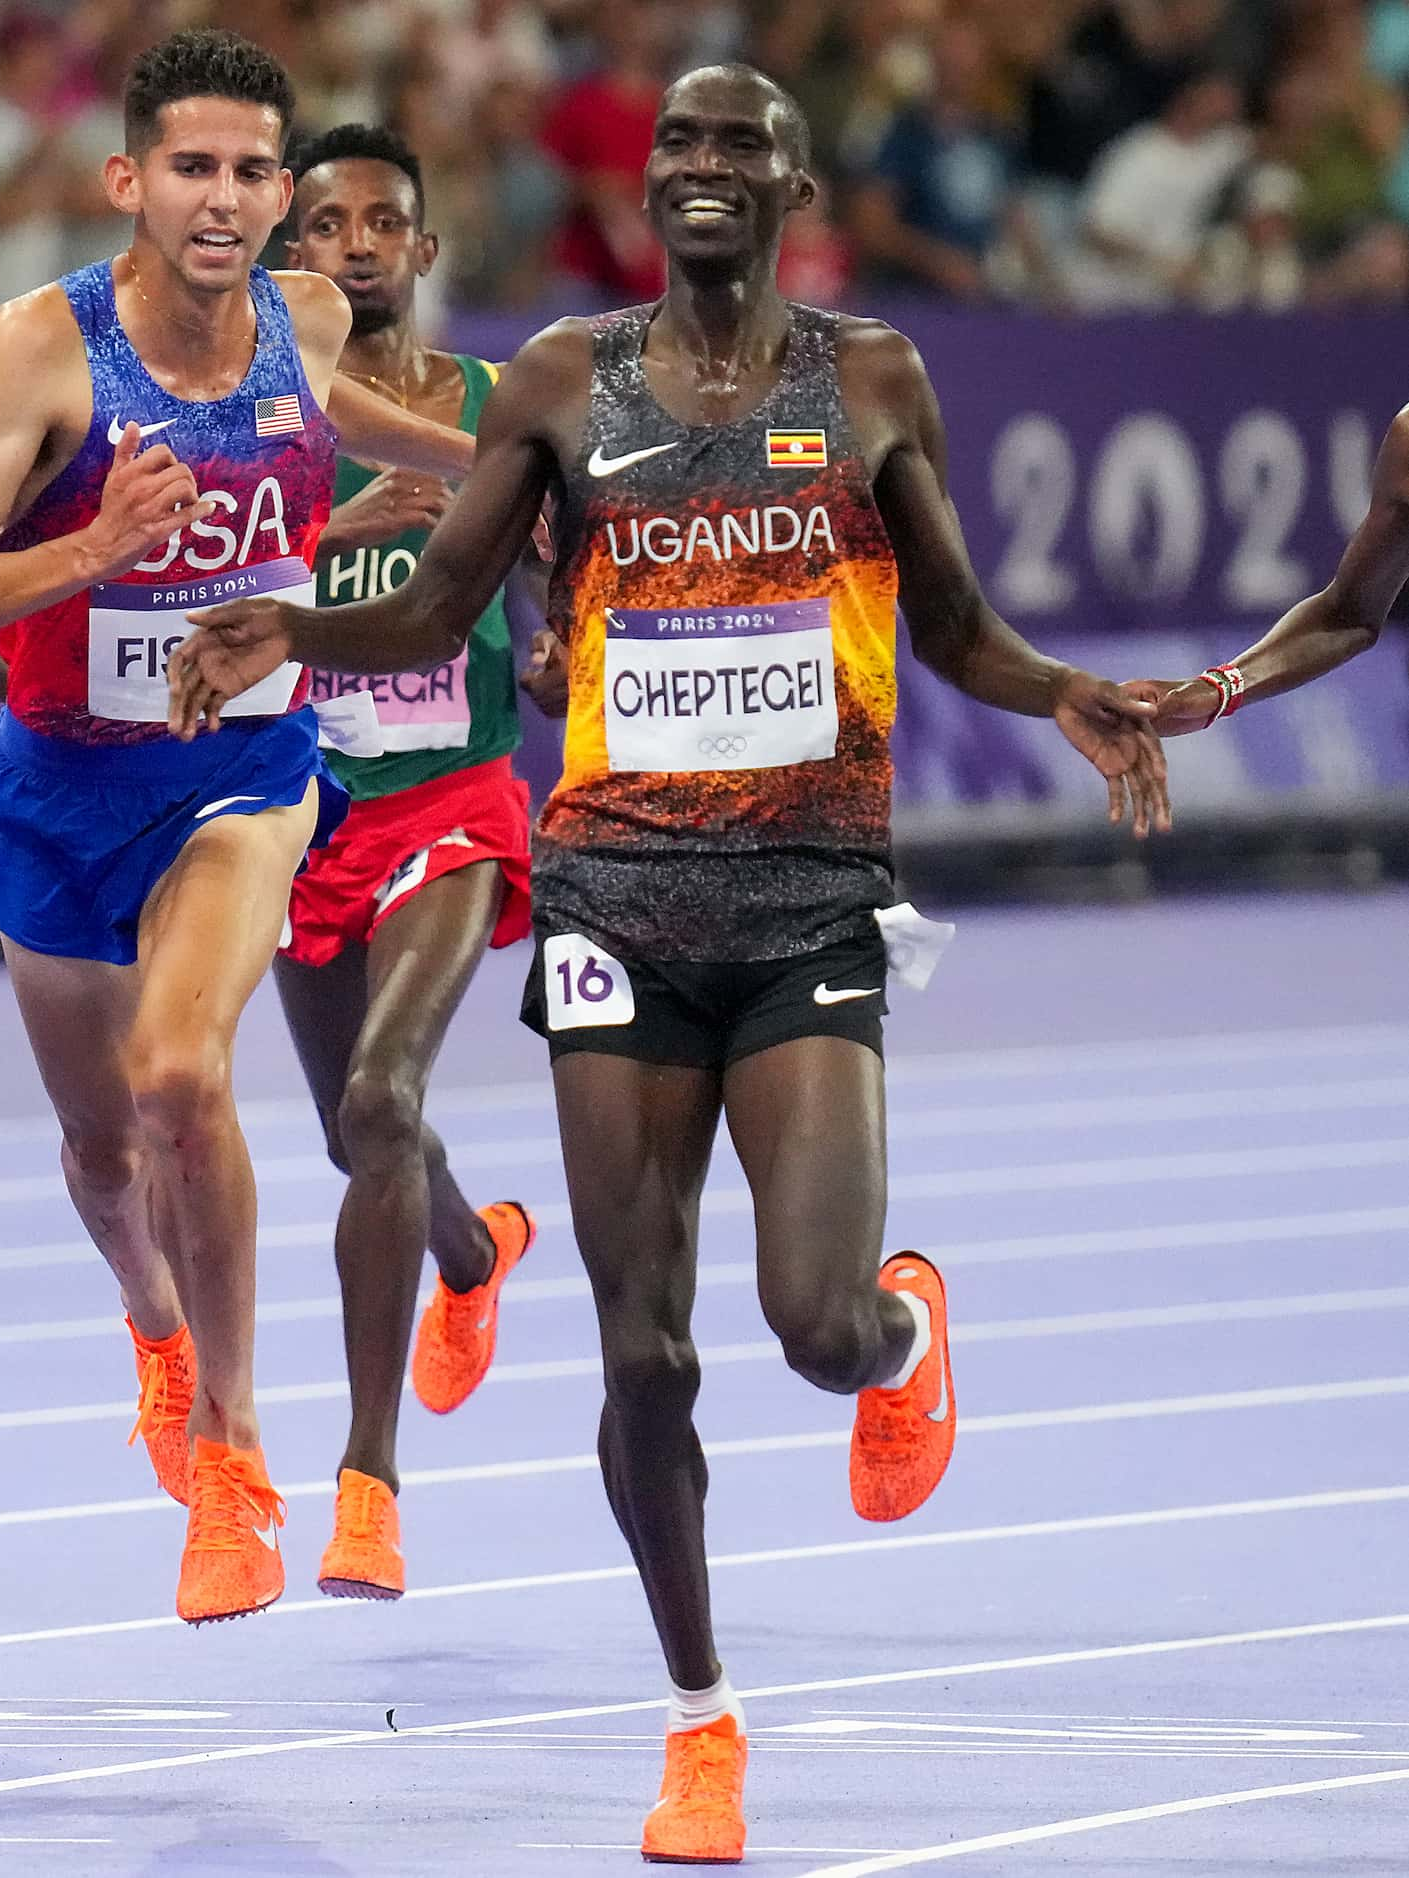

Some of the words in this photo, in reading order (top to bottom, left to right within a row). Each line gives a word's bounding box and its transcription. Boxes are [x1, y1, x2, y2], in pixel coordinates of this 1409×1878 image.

[606, 505, 836, 567] UGANDA
[152, 589, 208, 604] PARIS
[214, 573, 258, 596] 2024
[657, 616, 717, 633] PARIS
[723, 613, 776, 631] 2024
[613, 659, 824, 717] CHEPTEGEI
[556, 955, 614, 1005] 16
